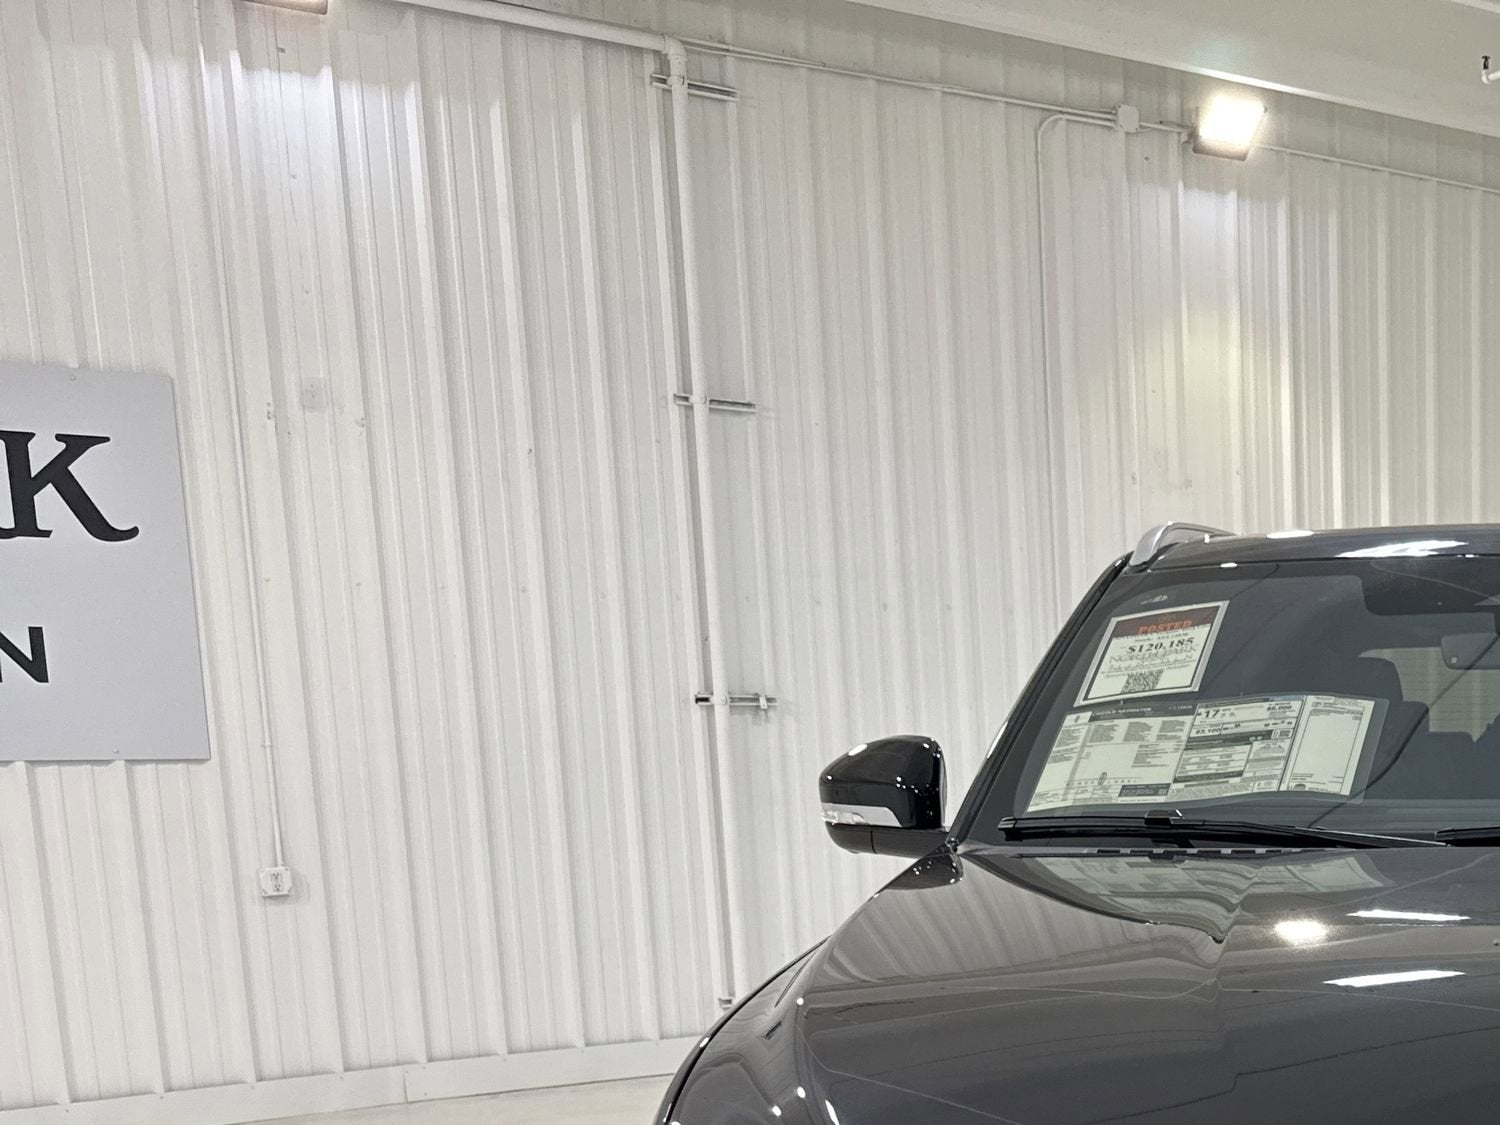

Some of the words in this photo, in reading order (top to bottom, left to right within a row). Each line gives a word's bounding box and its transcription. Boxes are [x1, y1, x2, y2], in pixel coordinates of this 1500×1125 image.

[0, 430, 139, 541] K
[1127, 637, 1195, 653] $120,185
[1204, 709, 1220, 719] 17
